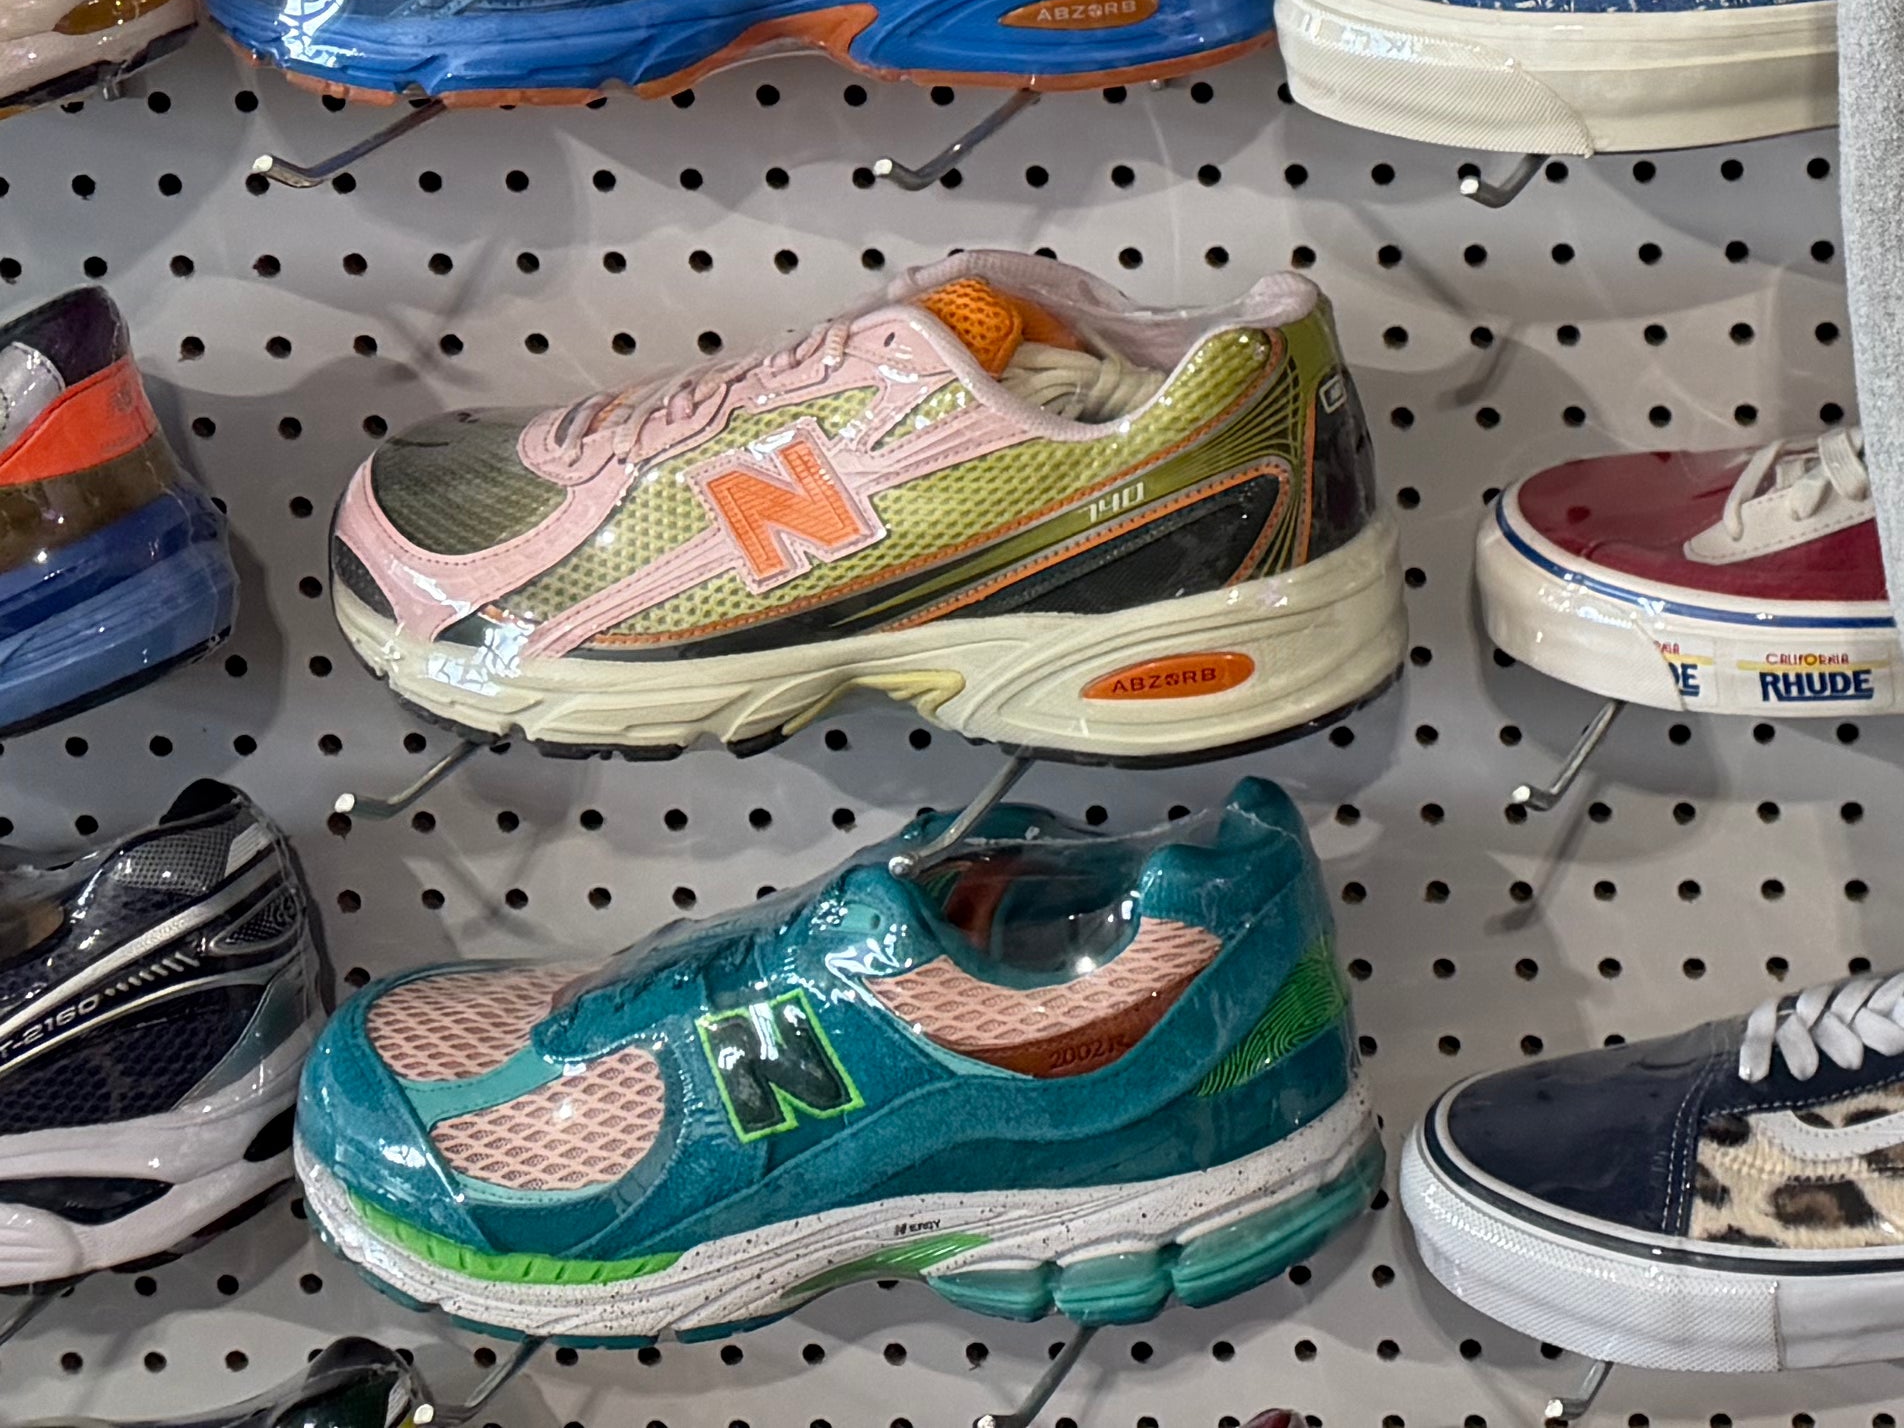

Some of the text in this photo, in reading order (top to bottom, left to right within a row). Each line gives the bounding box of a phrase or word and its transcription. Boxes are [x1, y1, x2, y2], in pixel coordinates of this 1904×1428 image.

[1037, 0, 1137, 21] ABZORB
[707, 439, 862, 580] N
[1078, 481, 1144, 523] 740
[1765, 652, 1850, 667] CALIFORNIA
[1112, 667, 1217, 694] ABZORB
[1759, 669, 1875, 702] RHUDE
[0, 993, 101, 1059] T-2160
[694, 987, 866, 1144] N
